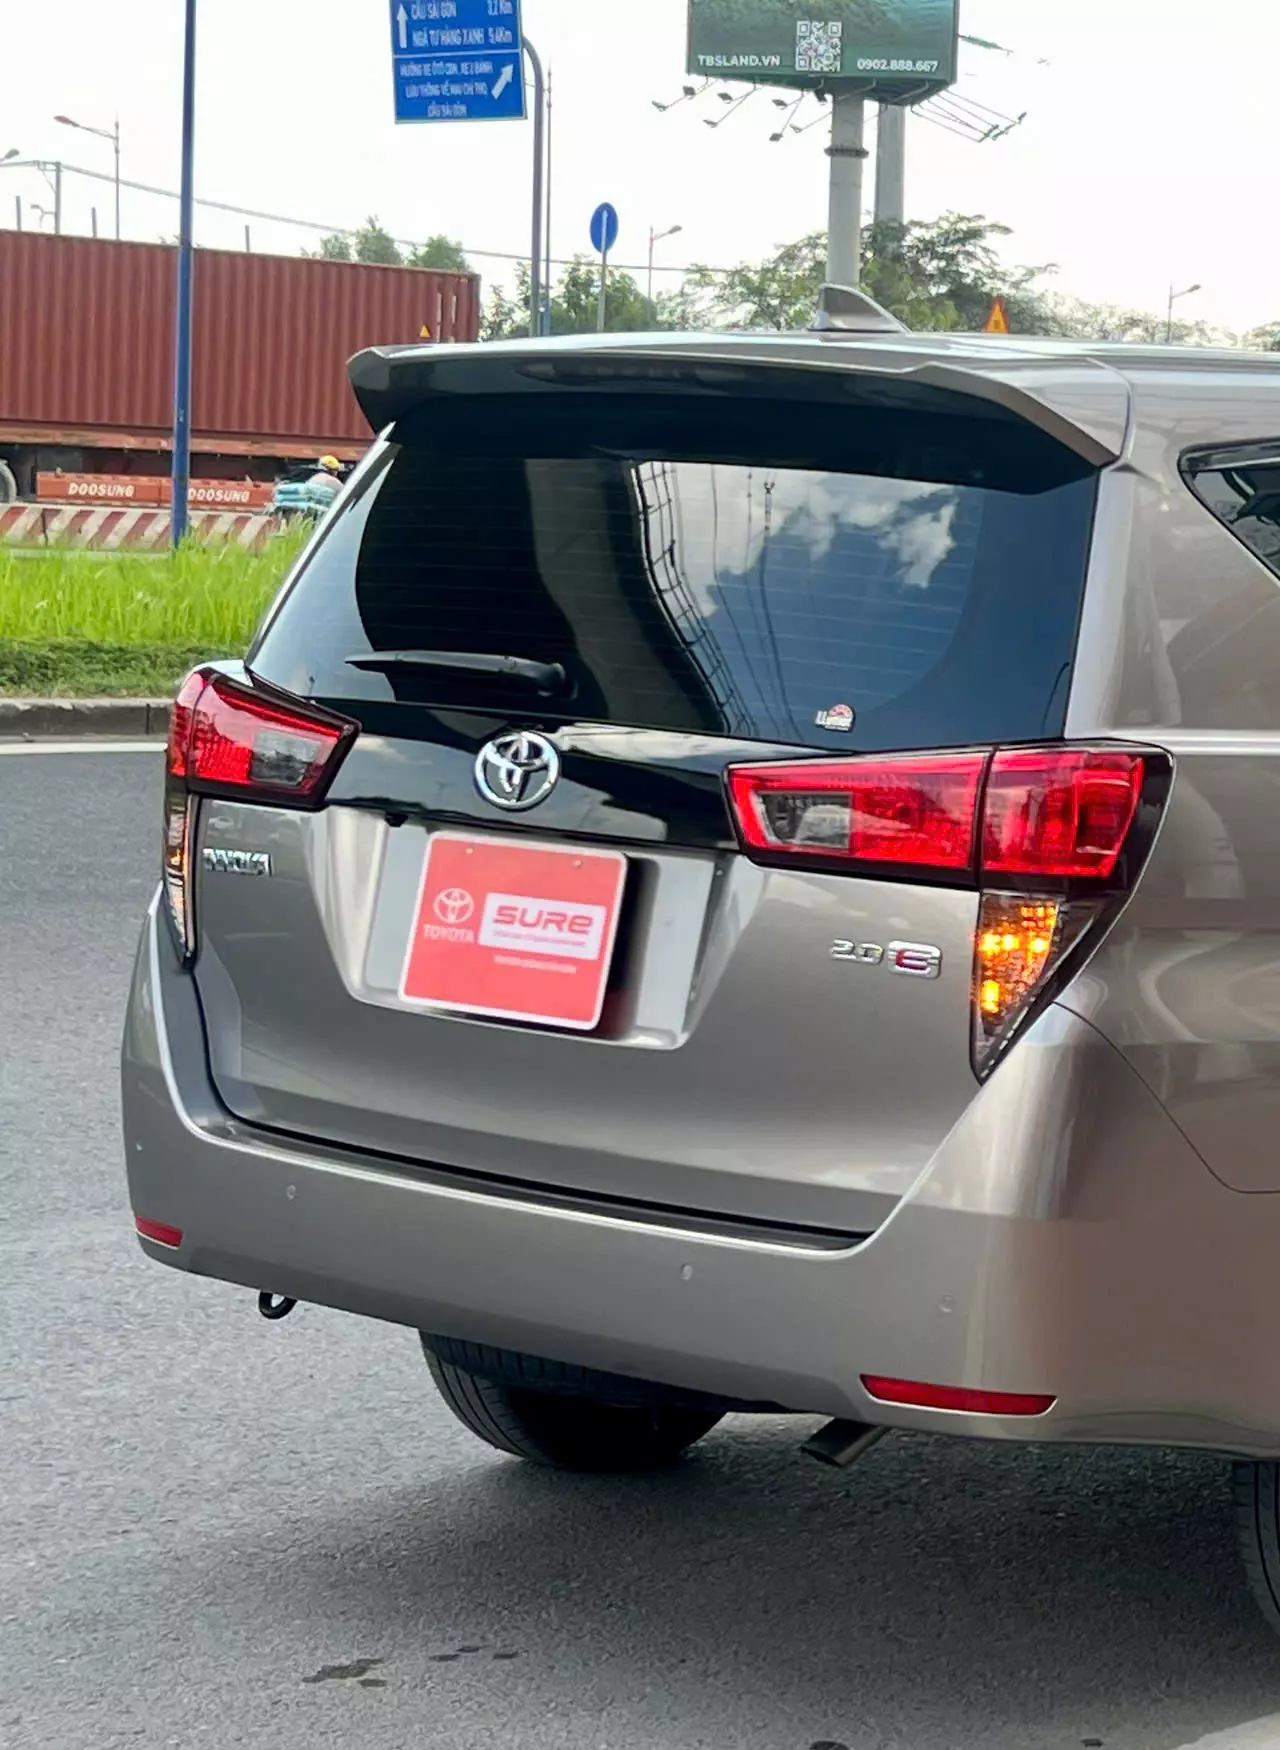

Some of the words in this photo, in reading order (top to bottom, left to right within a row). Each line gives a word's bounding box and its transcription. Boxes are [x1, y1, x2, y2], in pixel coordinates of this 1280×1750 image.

[697, 55, 780, 67] TBSLAND.VN
[857, 58, 938, 73] 0902.888.667
[68, 482, 134, 498] DOOSUNG
[188, 487, 250, 503] DOOSUNG
[422, 923, 475, 945] TOYOTA
